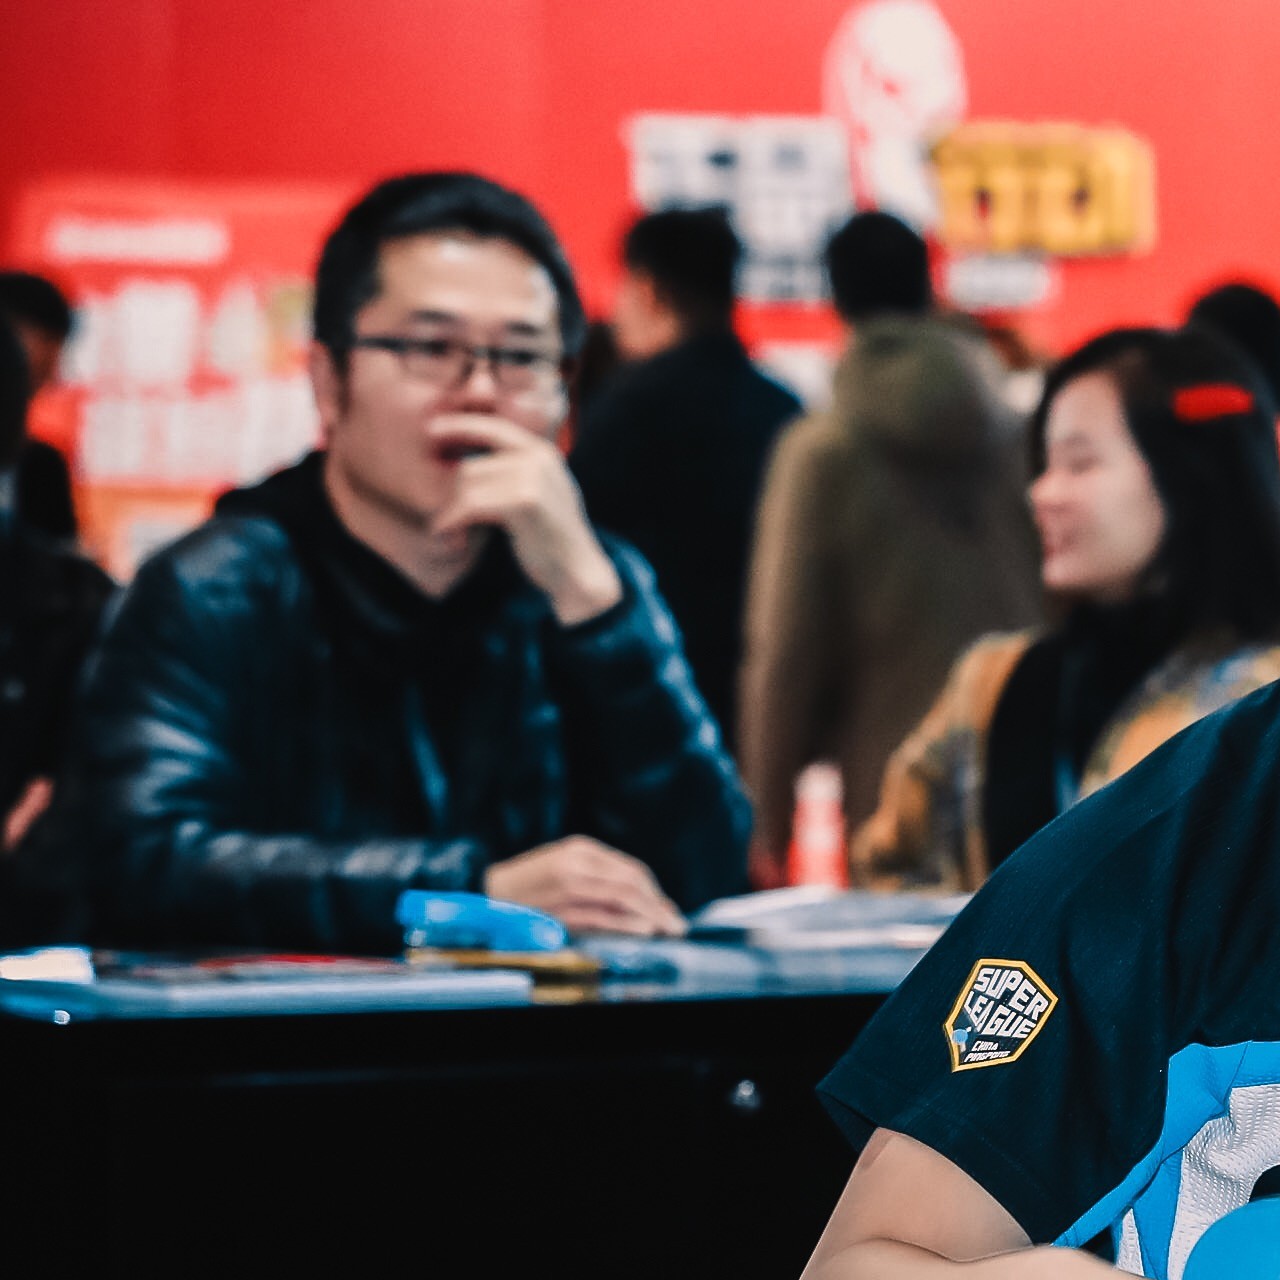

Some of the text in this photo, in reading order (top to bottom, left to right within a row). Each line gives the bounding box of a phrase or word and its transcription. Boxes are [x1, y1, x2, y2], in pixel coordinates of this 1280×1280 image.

[963, 990, 1037, 1039] LEAGUE
[973, 967, 1049, 1021] SUPER
[971, 1040, 999, 1052] CHINA
